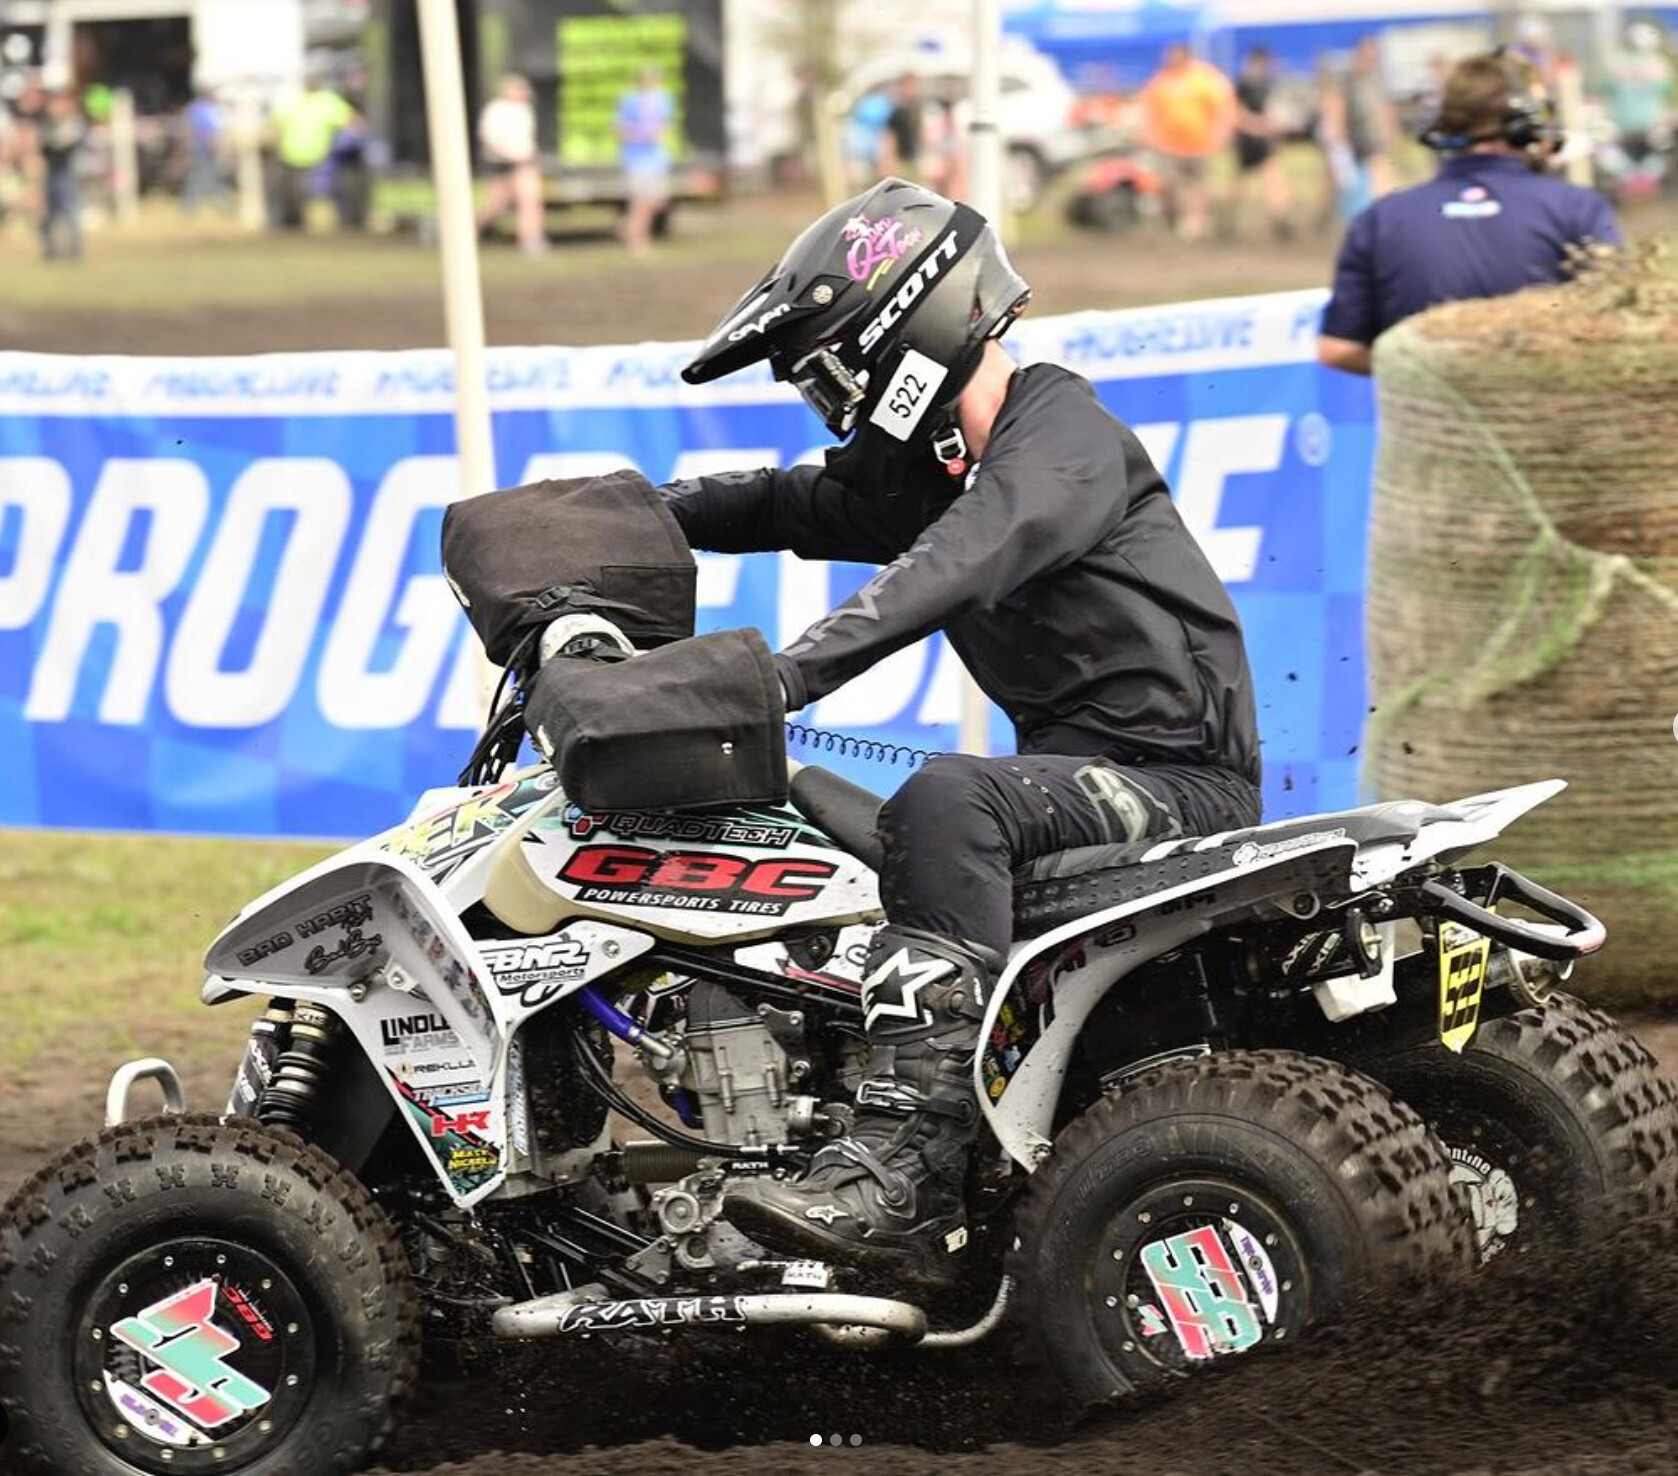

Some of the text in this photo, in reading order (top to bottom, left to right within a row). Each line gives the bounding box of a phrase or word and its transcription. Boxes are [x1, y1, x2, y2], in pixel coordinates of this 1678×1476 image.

[859, 230, 957, 355] SCOTT
[888, 373, 928, 420] 522
[611, 813, 793, 846] QUADTECH
[562, 843, 840, 897] GBC
[583, 887, 784, 915] POWERSPORTS TIRES
[490, 939, 590, 974] BNR
[500, 967, 586, 983] Motorsports
